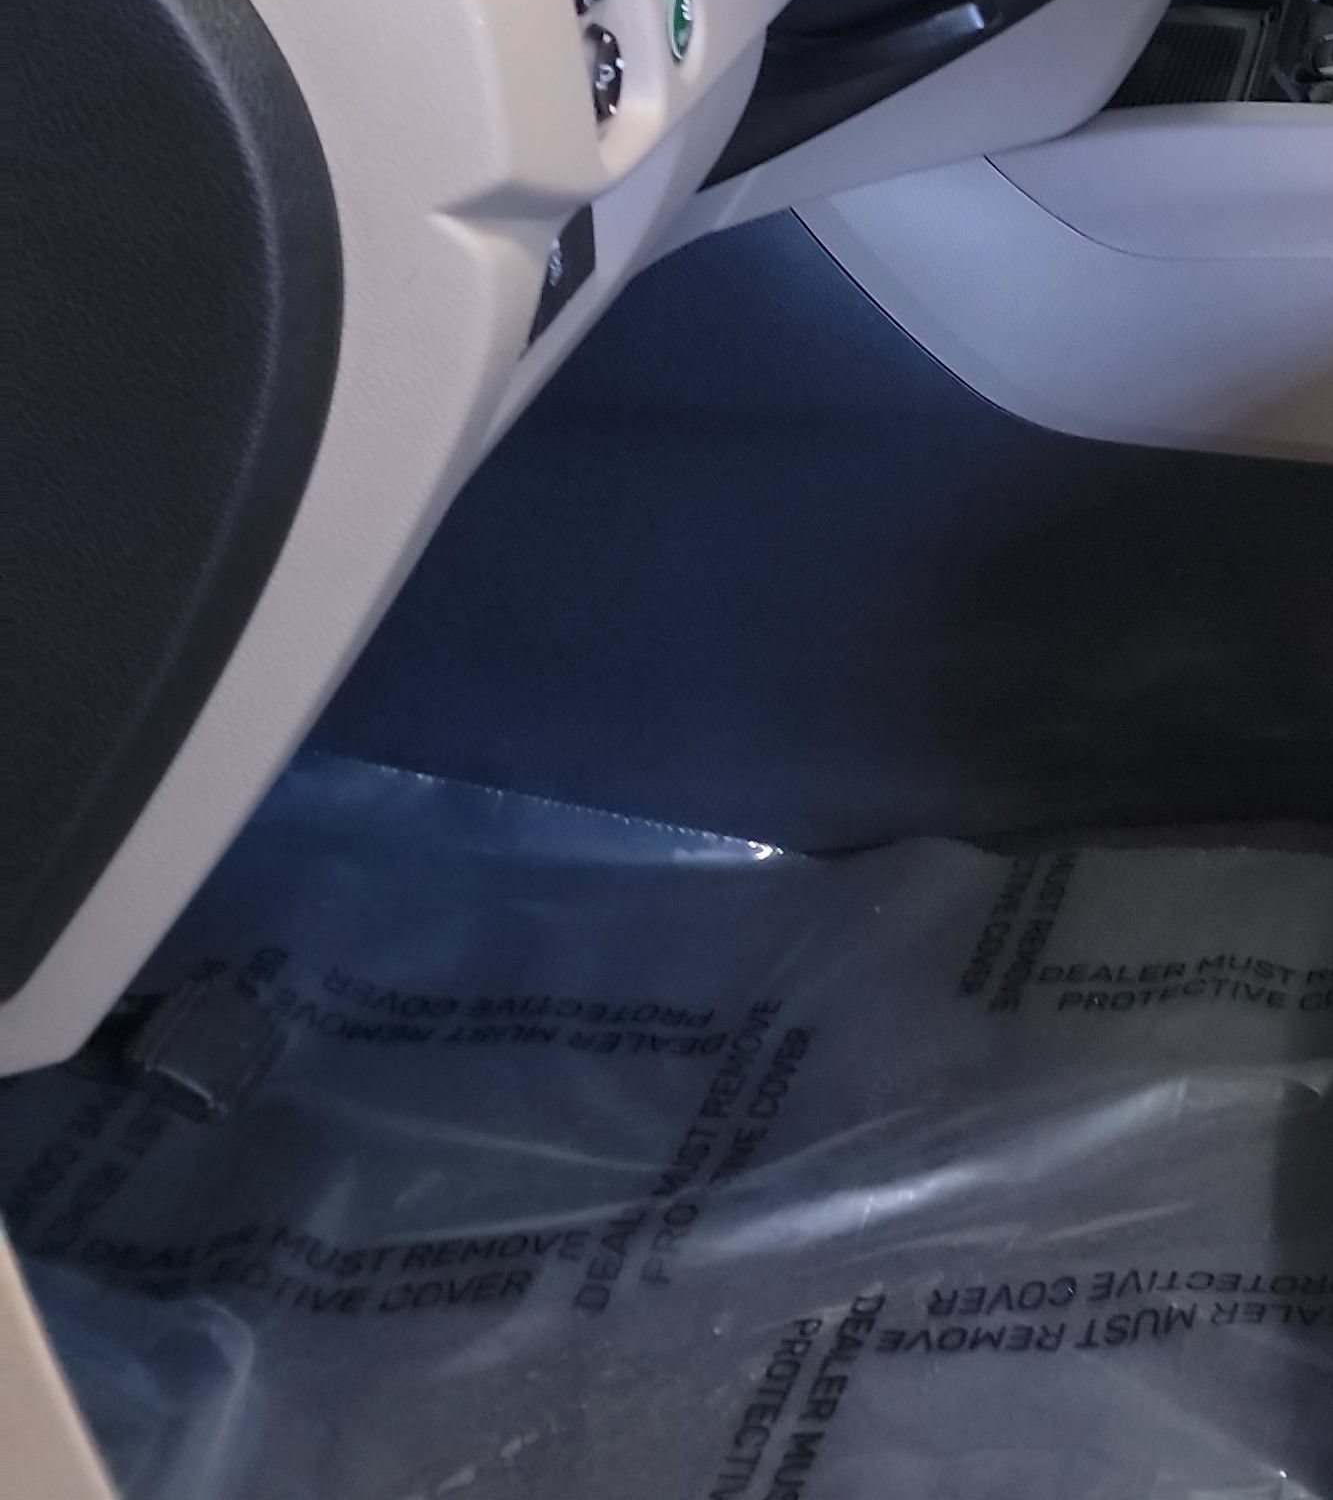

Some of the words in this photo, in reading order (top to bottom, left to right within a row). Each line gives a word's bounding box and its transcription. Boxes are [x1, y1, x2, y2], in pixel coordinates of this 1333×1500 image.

[1037, 958, 1188, 987] DEALER
[1199, 954, 1297, 988] MUST
[468, 996, 716, 1028] PROTECTIVE
[1057, 982, 1288, 1013] PROTECTIVE
[567, 1029, 730, 1057] DEALER
[698, 996, 784, 1120] REMOVE
[399, 1228, 592, 1273] REMOVE
[378, 1268, 535, 1314] COVER
[926, 1277, 1079, 1317] COVER
[874, 1321, 1064, 1354] REMOVE
[1074, 1301, 1200, 1351] MUST
[800, 1293, 888, 1421] DEALER
